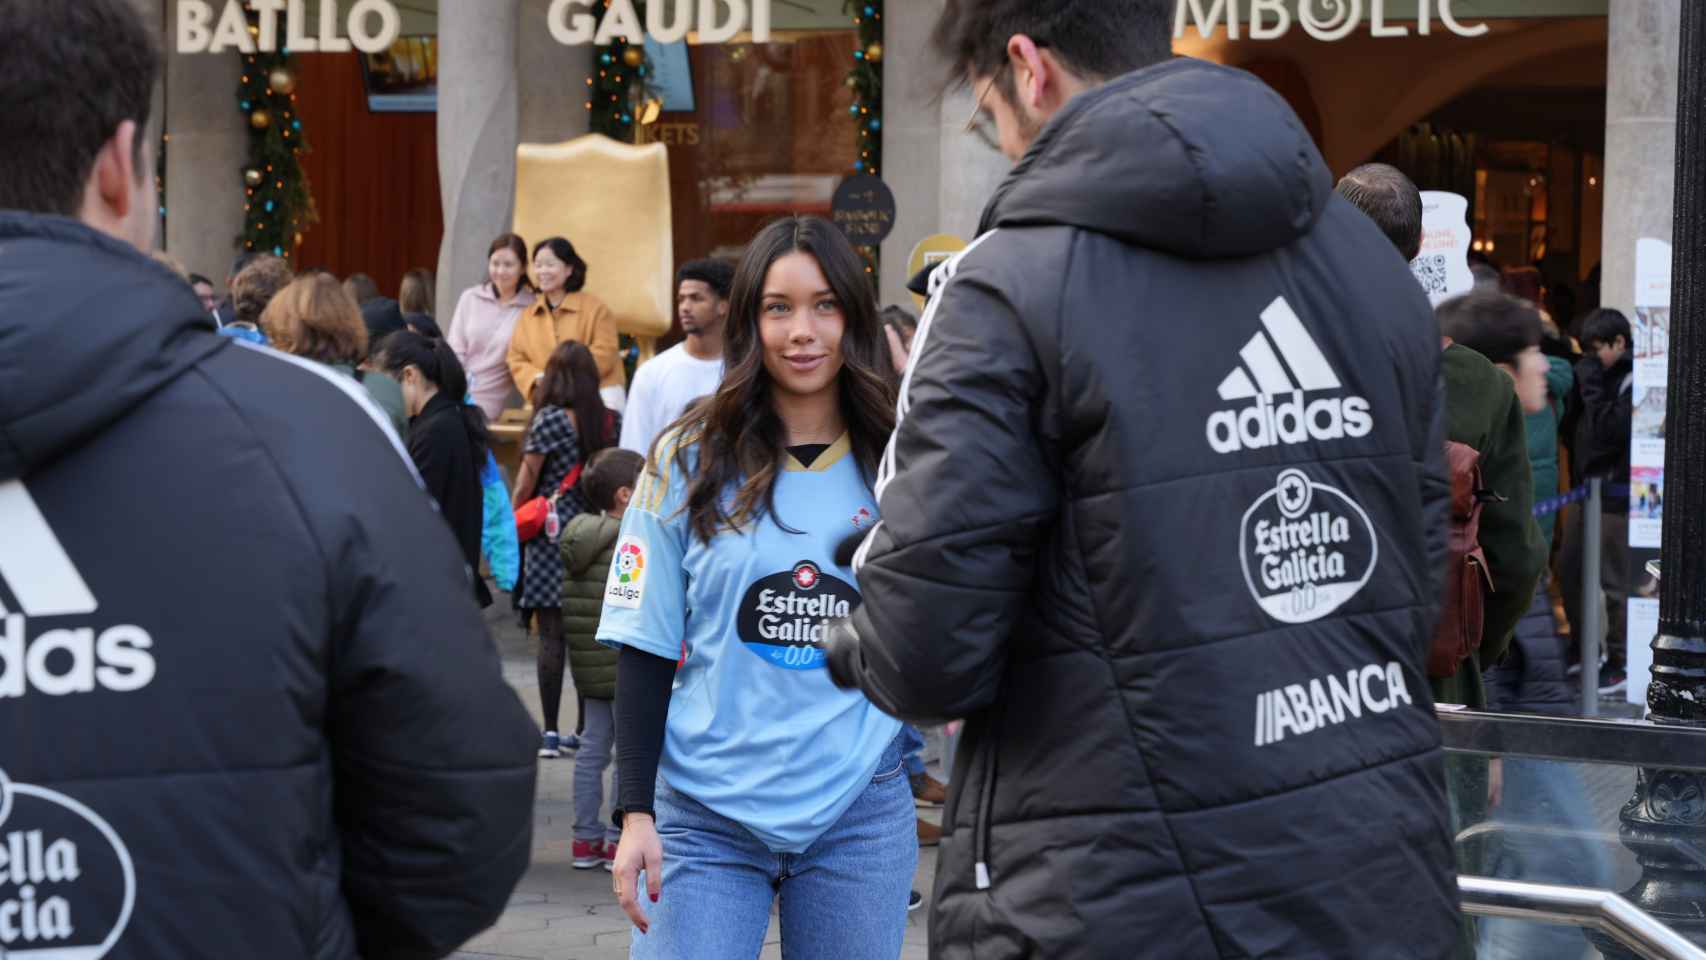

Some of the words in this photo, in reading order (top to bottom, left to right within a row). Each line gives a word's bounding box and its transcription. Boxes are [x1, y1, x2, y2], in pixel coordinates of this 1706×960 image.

[1172, 0, 1489, 41] MBOLIC
[1206, 389, 1373, 453] adidas
[1254, 511, 1350, 555] Estrella
[1261, 545, 1346, 590] Galicia
[756, 588, 850, 618] Estrella
[758, 614, 834, 643] Galici
